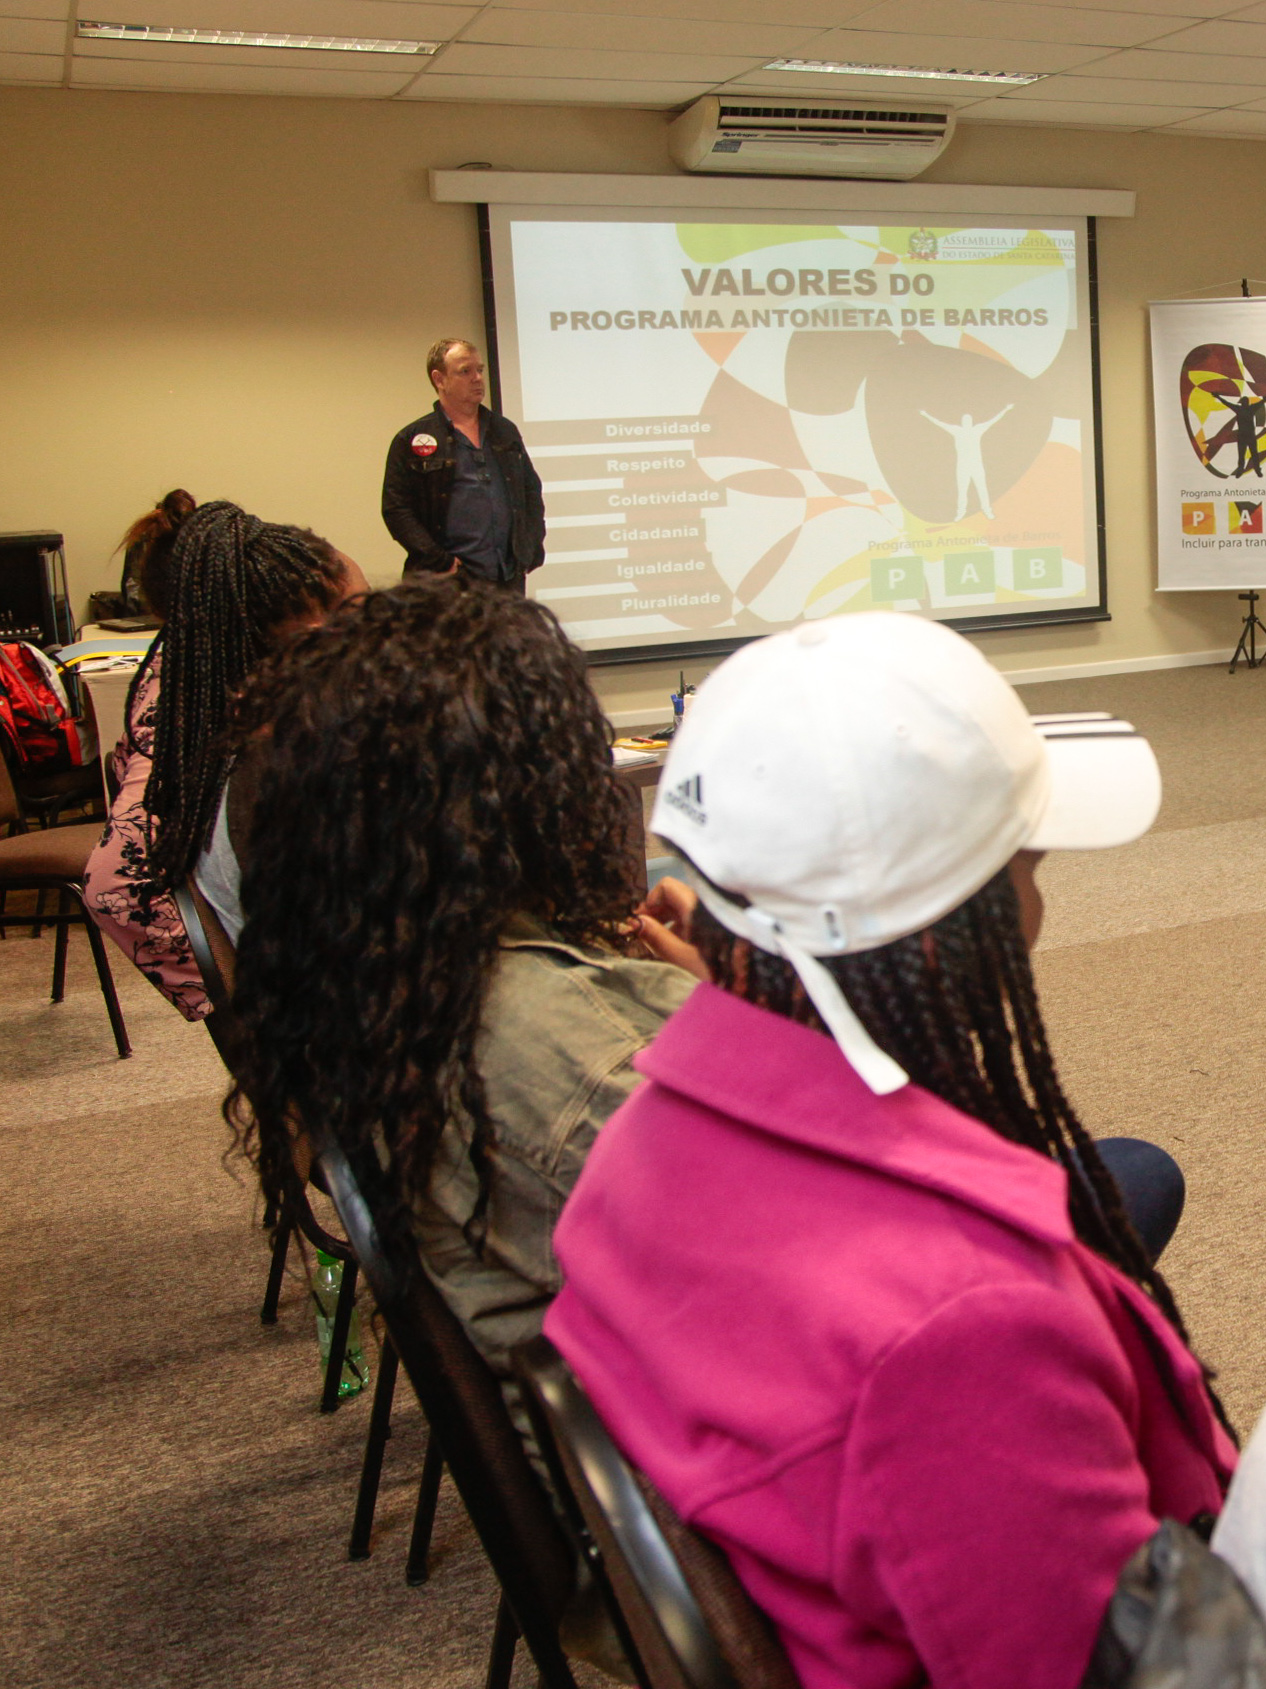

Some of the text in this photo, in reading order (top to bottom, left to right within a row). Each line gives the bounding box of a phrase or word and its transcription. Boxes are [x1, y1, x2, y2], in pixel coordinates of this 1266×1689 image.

[943, 236, 1075, 248] ASSEMBLEIA LEGISLATIVA
[681, 268, 935, 297] VALORES DO
[550, 308, 1049, 332] PROGRAMA ANTONIETA DE BARROS
[605, 421, 711, 437] Diversidade
[607, 457, 686, 473] Respeito
[608, 490, 720, 507] Coletividade
[1180, 489, 1222, 499] Programa
[1224, 487, 1266, 497] Antonieta
[1192, 509, 1253, 527] P A
[609, 525, 699, 542] Cidadania
[868, 540, 933, 552] Programa
[936, 534, 1000, 547] Antonieta
[1181, 538, 1216, 549] Incluir
[1218, 539, 1242, 550] para
[617, 559, 705, 579] Igualdade
[888, 558, 1046, 590] P A B
[621, 592, 721, 611] Pluralidade
